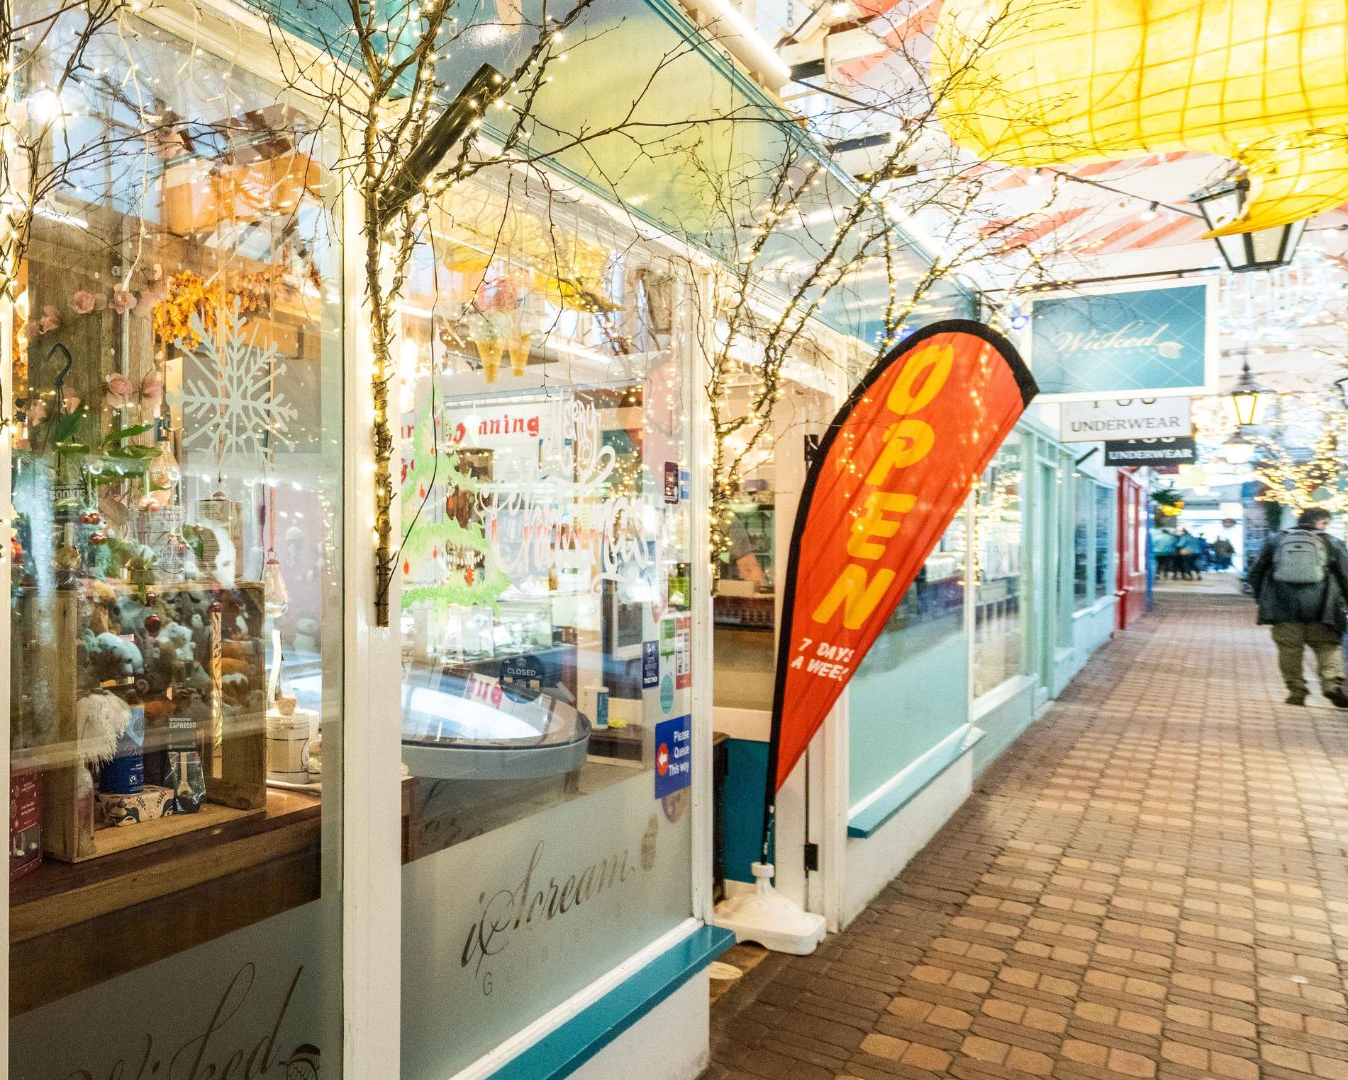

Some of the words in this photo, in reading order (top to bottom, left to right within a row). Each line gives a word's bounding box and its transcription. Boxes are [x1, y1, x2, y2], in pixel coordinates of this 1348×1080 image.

[1053, 319, 1170, 352] Wicked
[1070, 416, 1181, 433] UNDERWEAR
[1108, 449, 1193, 460] UNDERWEAR
[812, 344, 954, 630] OPEN
[798, 637, 813, 651] 7
[816, 642, 855, 663] DAYS
[791, 655, 805, 670] A
[507, 667, 537, 677] CLOSED
[169, 721, 197, 729] ESPRESSO
[673, 730, 690, 743] Please
[674, 745, 690, 759] Queue
[668, 764, 679, 777] This
[680, 762, 690, 773] way
[64, 962, 304, 1080] Wked
